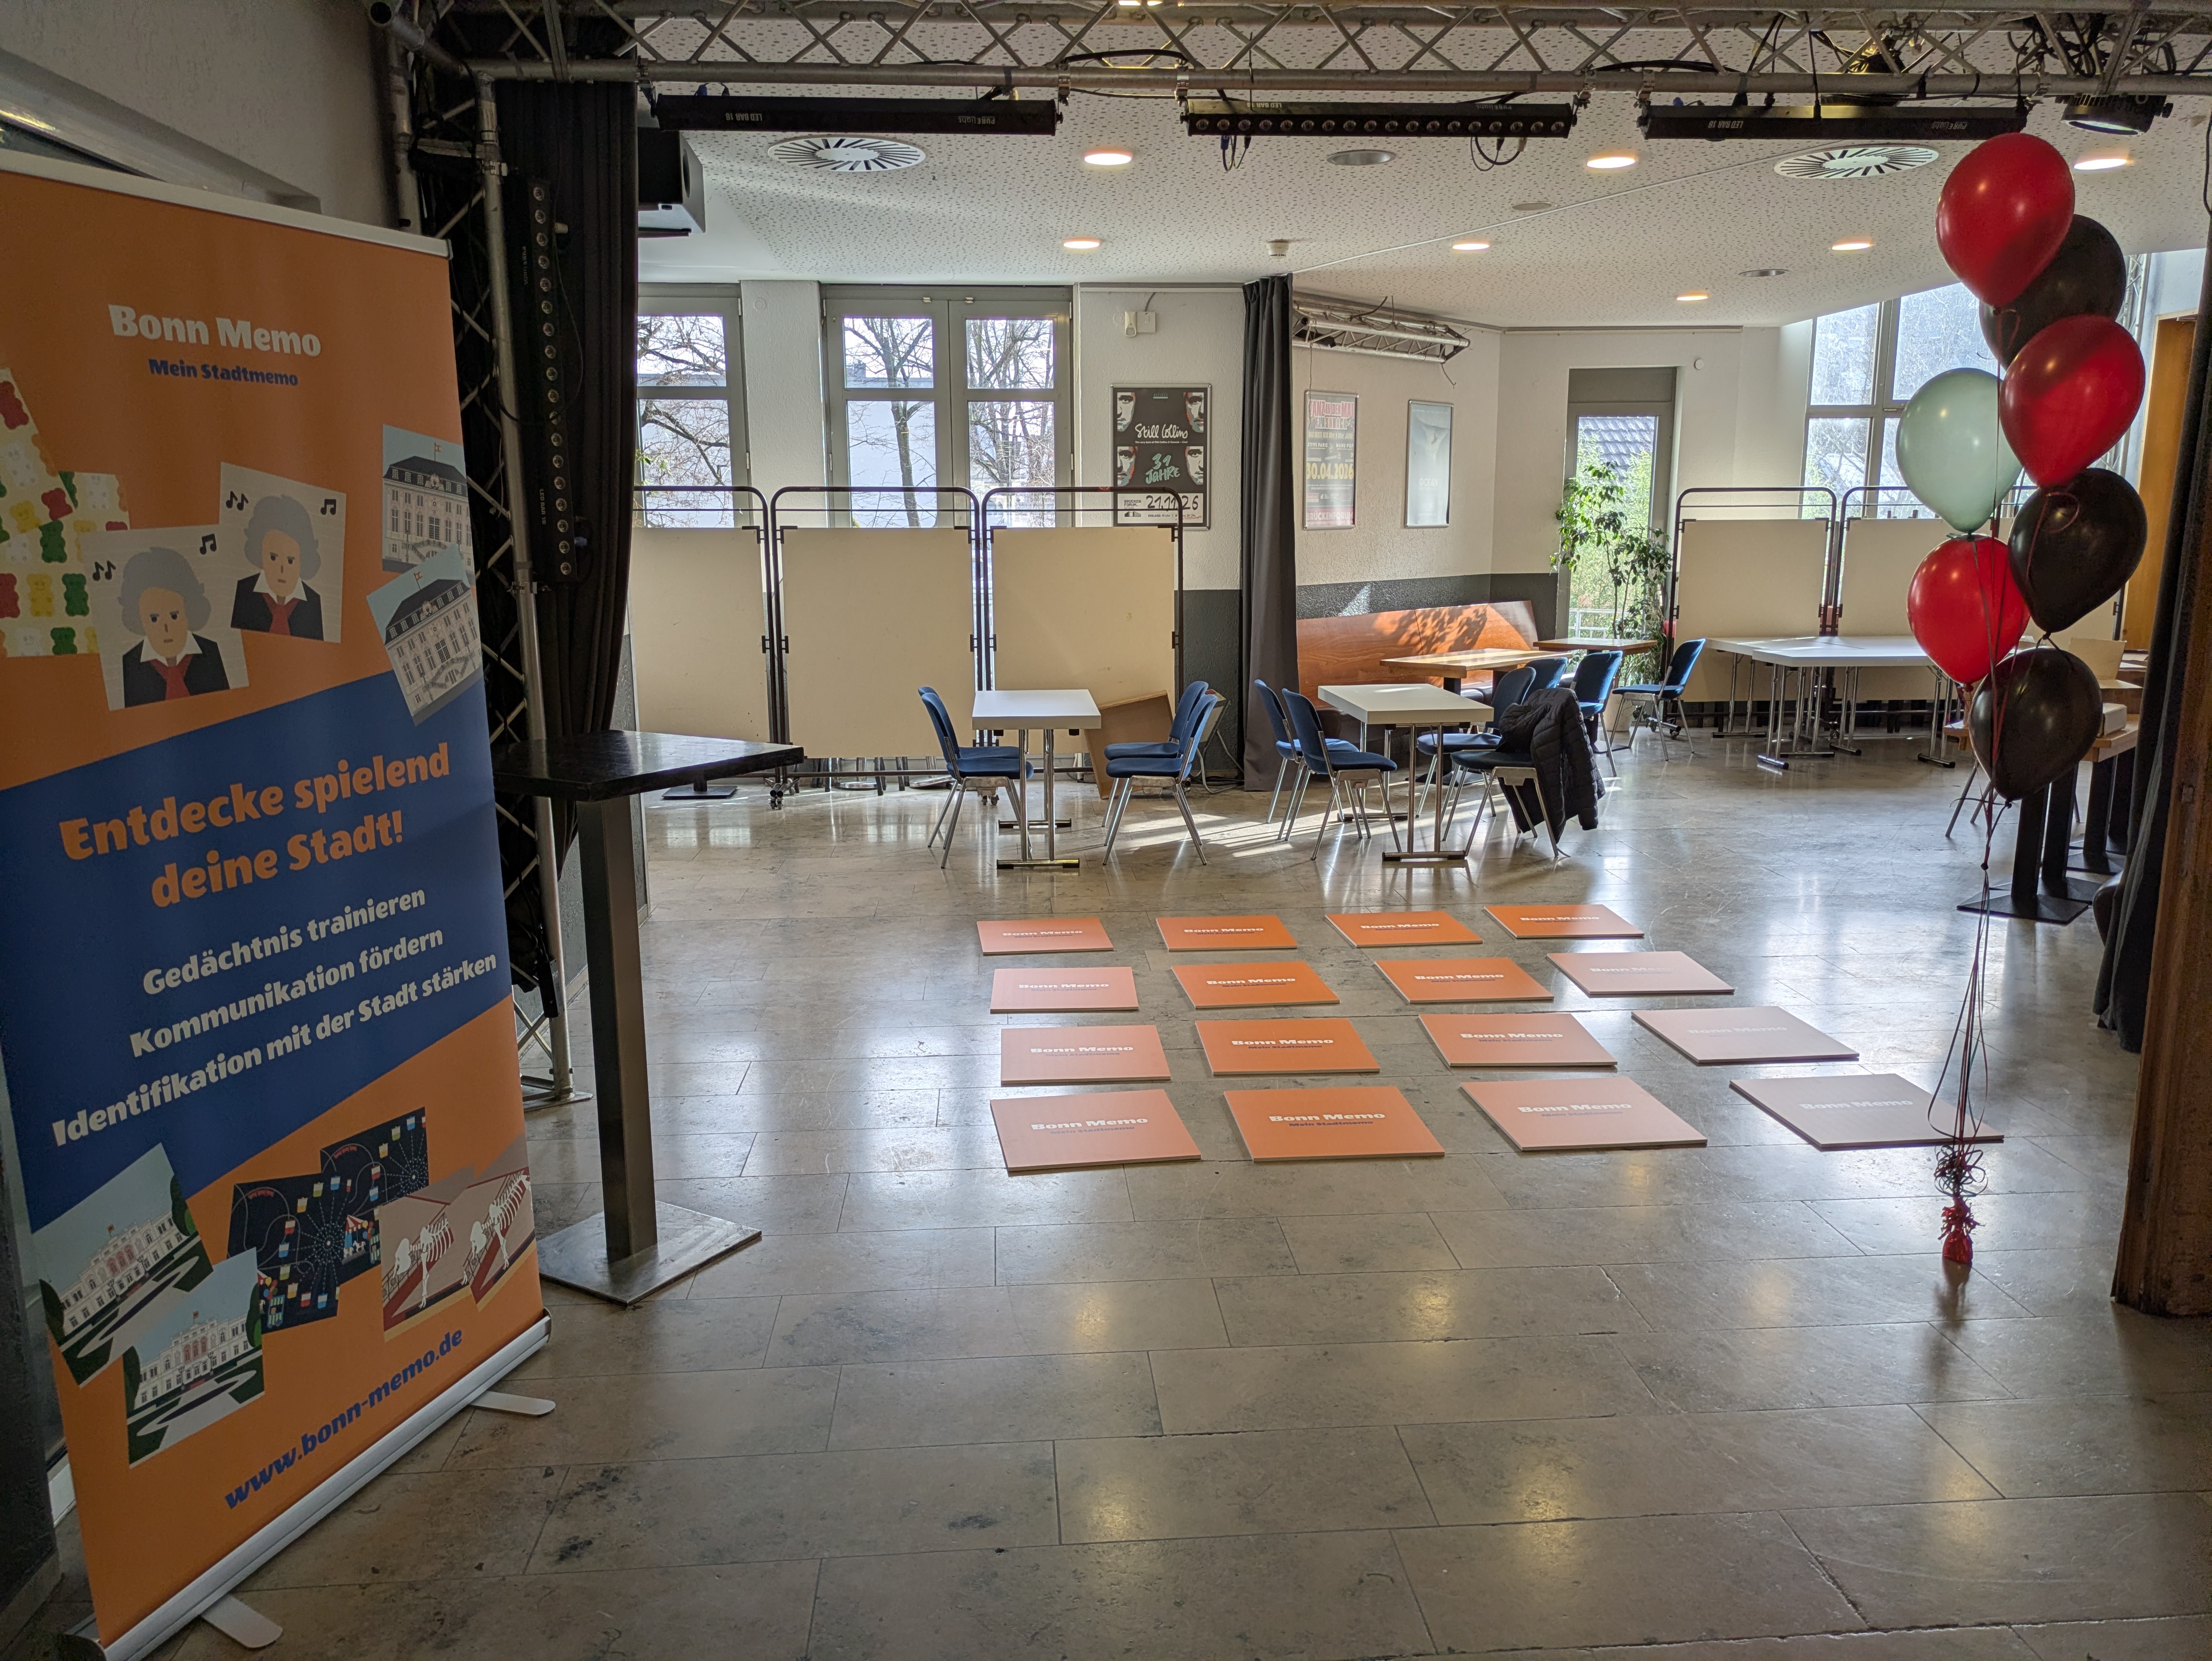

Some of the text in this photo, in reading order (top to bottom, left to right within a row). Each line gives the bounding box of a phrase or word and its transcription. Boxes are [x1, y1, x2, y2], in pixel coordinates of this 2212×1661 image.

[725, 112, 733, 121] 18
[735, 113, 749, 121] BAR
[108, 304, 321, 356] Bonn Memo
[148, 359, 299, 386] Mein Stadtmemo
[1135, 423, 1188, 439] Still Collins
[1152, 453, 1172, 469] 31
[1306, 463, 1354, 479] 30.04.2026
[59, 742, 450, 860] Entdecke spielend
[151, 809, 403, 908] deine Stadt!
[143, 888, 425, 996] Gedächtnis trainieren
[129, 929, 443, 1057] Kommunikation fördern
[53, 952, 497, 1146] Identifikation mit der Stadt stärken
[224, 1329, 463, 1509] www.bonn-memo.de
